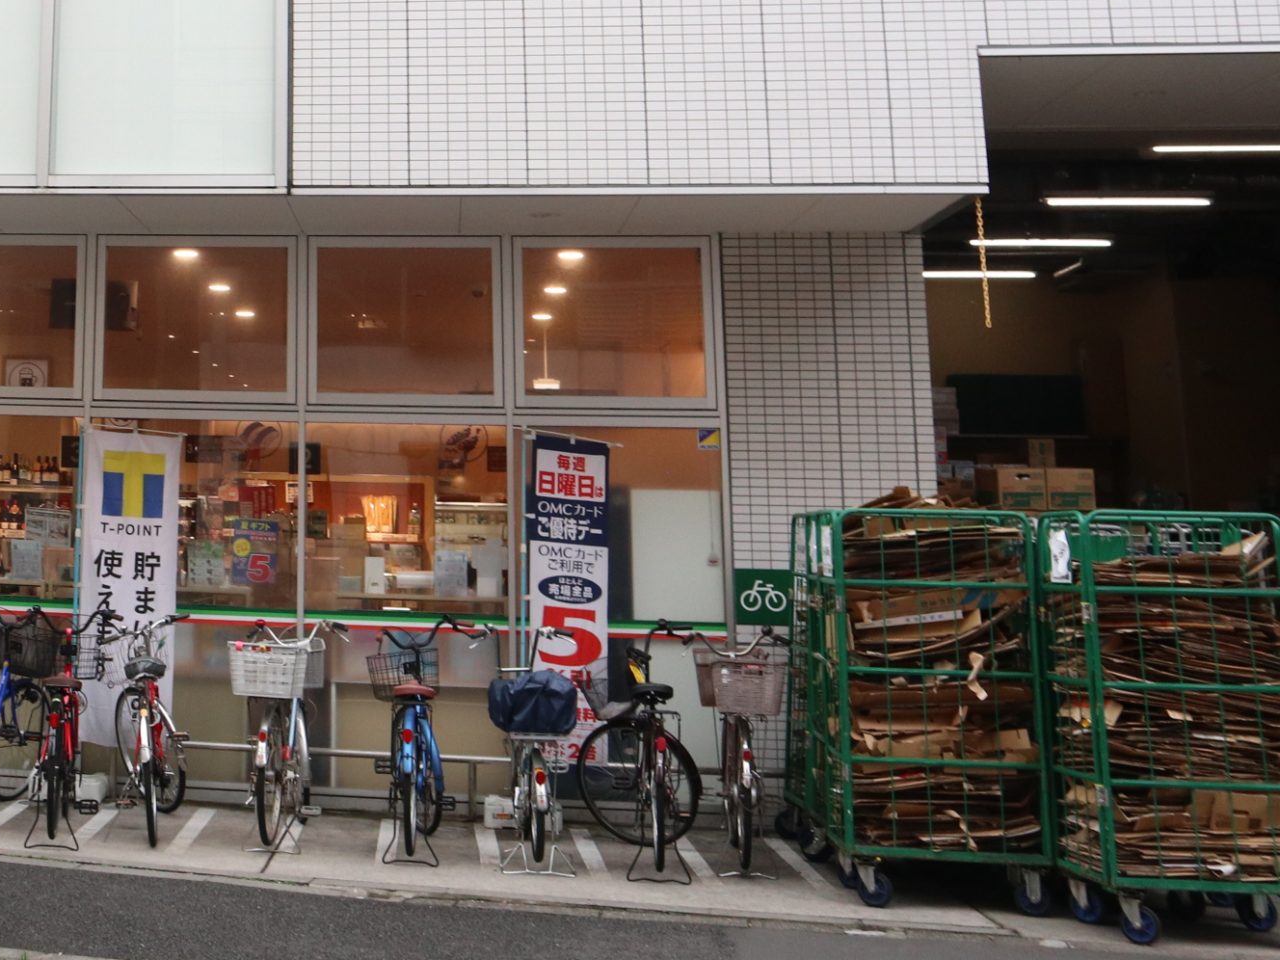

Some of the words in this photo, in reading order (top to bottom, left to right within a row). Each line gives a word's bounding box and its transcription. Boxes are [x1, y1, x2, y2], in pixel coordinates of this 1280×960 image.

[557, 454, 585, 473] 毎週
[538, 470, 604, 499] 日曜日は
[100, 521, 163, 537] T-POINT
[547, 558, 595, 575] ご利用で
[537, 605, 603, 667] 5
